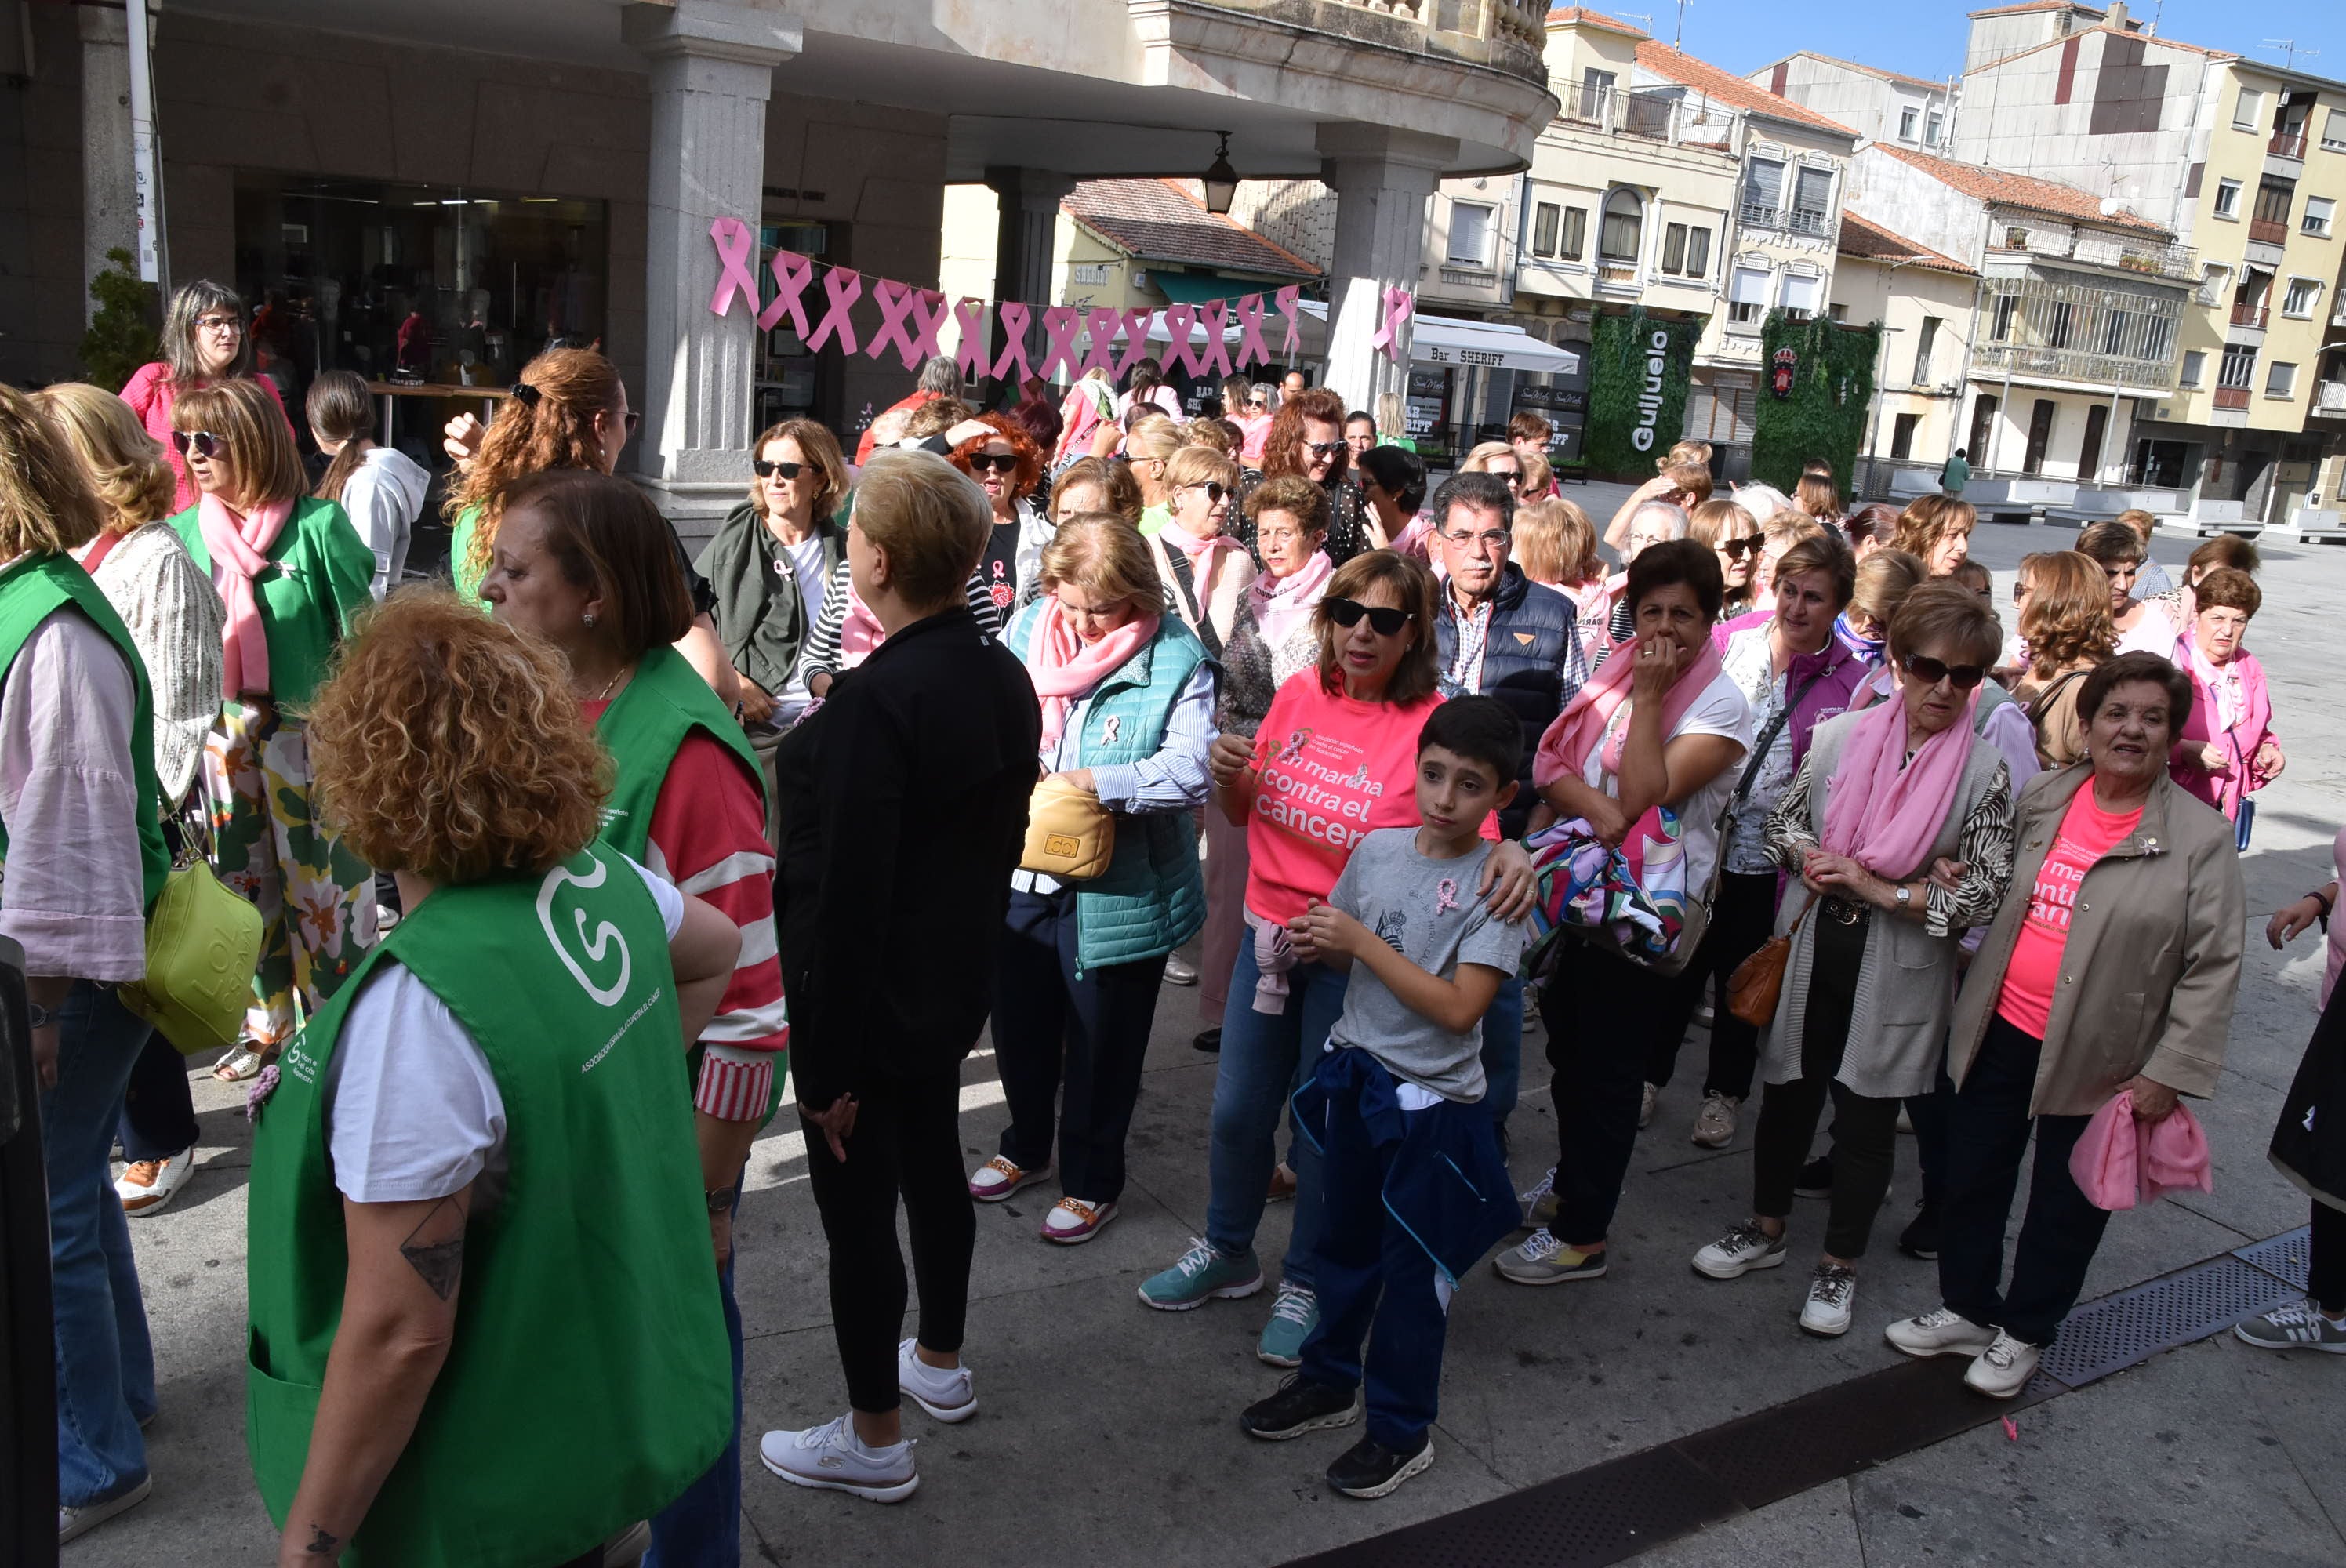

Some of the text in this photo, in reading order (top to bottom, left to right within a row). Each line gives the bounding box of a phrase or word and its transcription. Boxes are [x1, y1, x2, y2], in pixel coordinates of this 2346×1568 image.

[1431, 347, 1505, 366] Bar SHERIFF
[1631, 331, 1668, 452] Guijuelo
[1405, 419, 1433, 433] RIFF
[1255, 793, 1366, 850] cáncer
[1263, 768, 1372, 823] contra el
